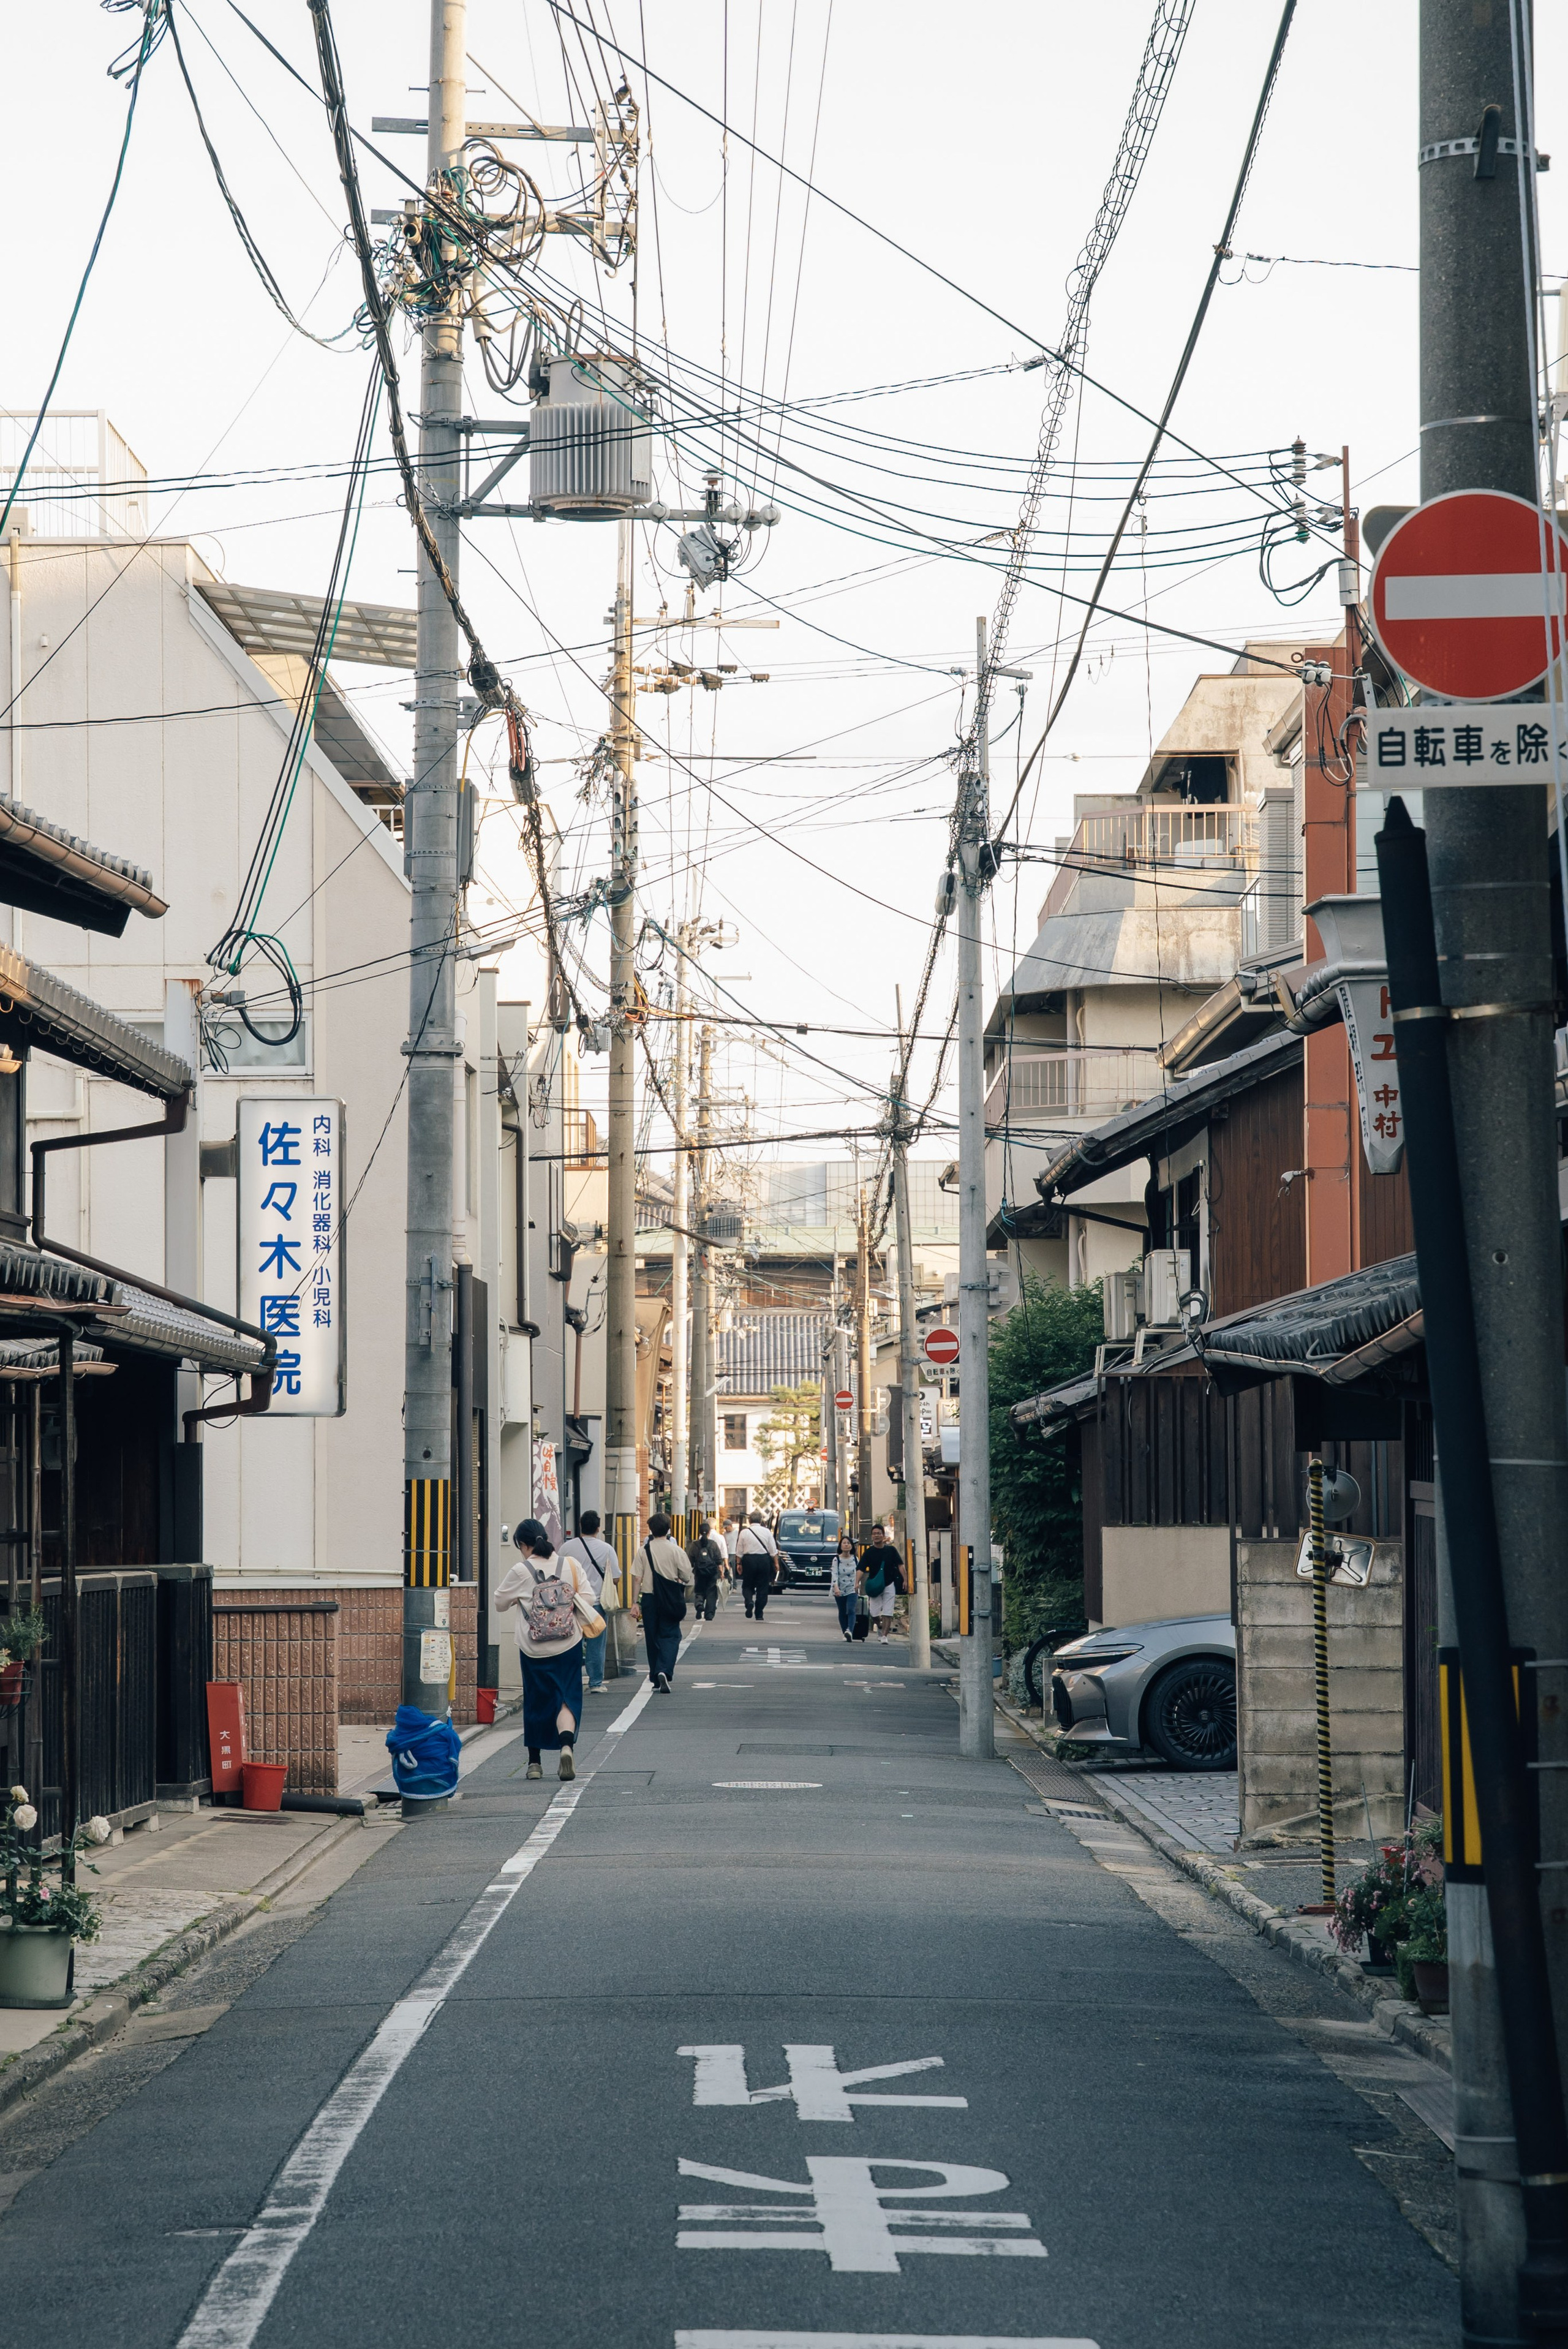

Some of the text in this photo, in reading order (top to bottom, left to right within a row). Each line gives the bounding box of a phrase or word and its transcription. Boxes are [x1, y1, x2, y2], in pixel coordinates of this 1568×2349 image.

[1378, 722, 1568, 768] 自転車を除く
[312, 1114, 331, 1329] 内科 消化器科 小児科
[220, 1730, 232, 1769] 大黒町
